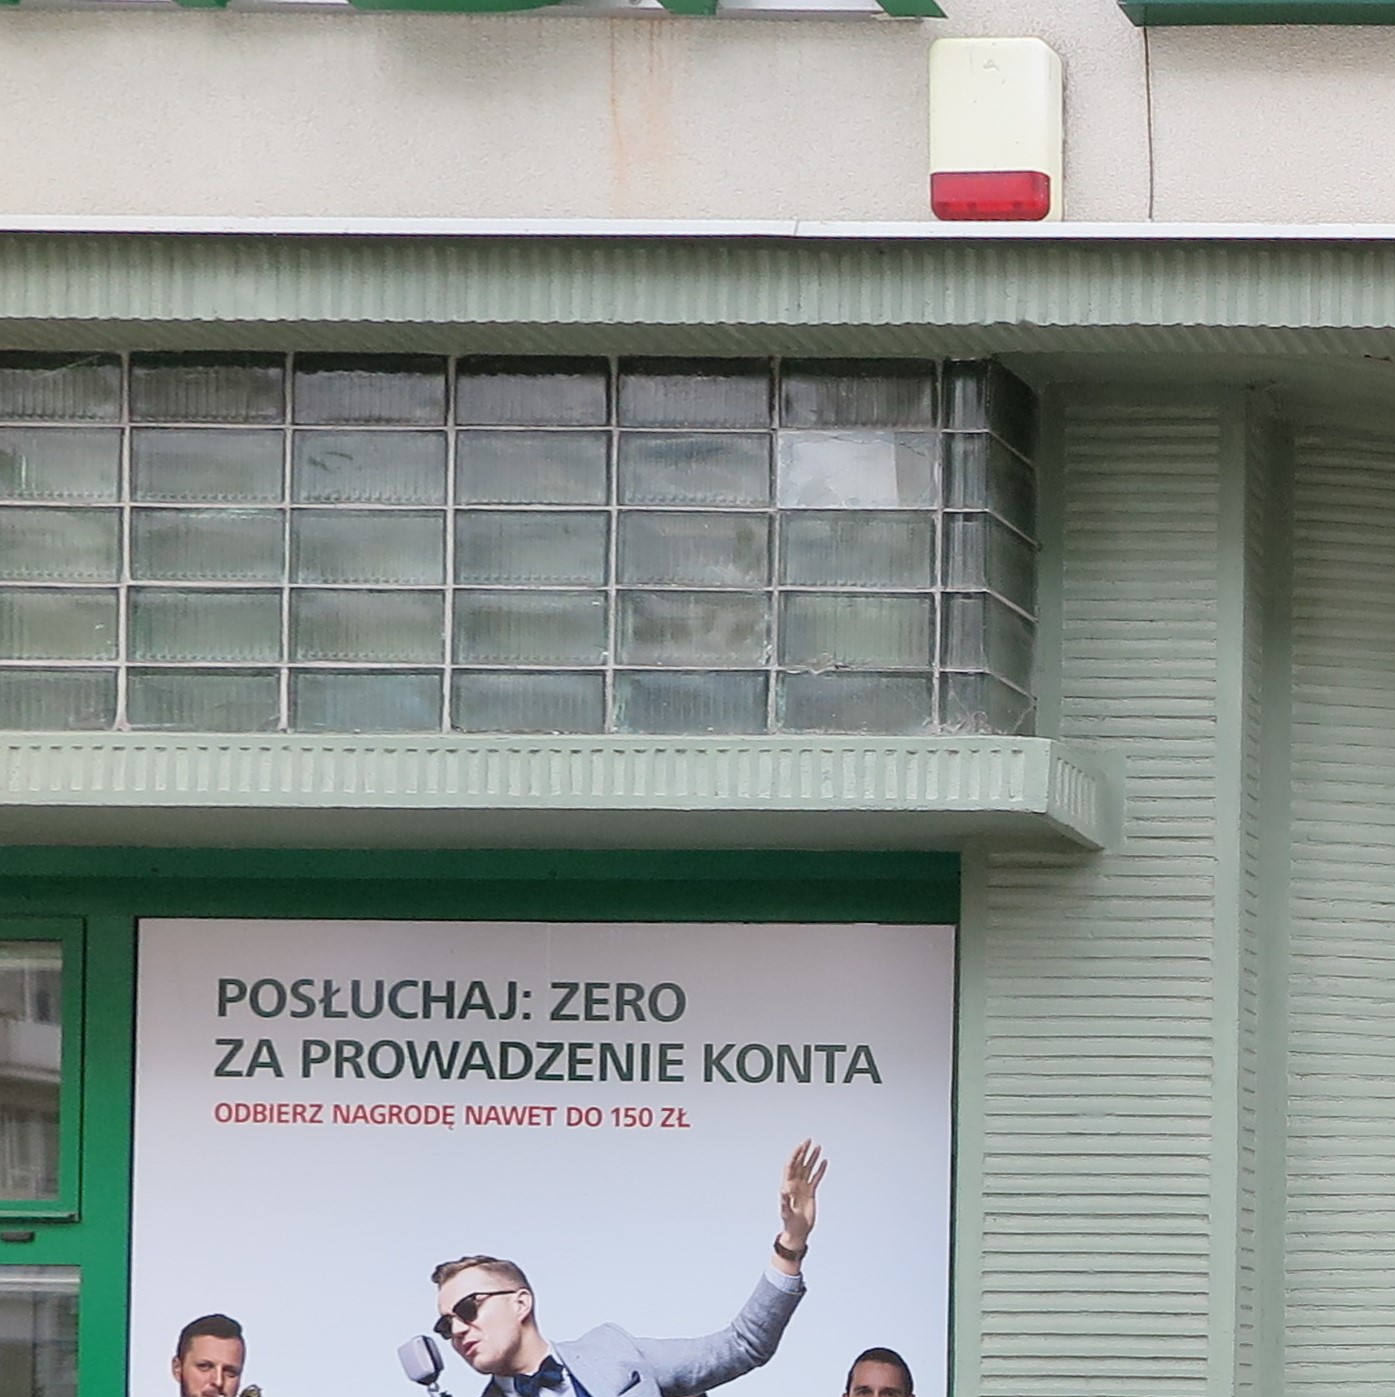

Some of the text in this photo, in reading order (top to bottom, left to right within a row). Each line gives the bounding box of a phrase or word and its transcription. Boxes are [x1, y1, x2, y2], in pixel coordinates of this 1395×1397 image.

[217, 978, 687, 1022] POSŁUCHAJ: ZERO
[214, 1038, 882, 1084] ZA PROWADZENIE KONTA
[214, 1103, 690, 1130] ODBIERZ NAGRODĘ NAWET DO 150 ZŁ
